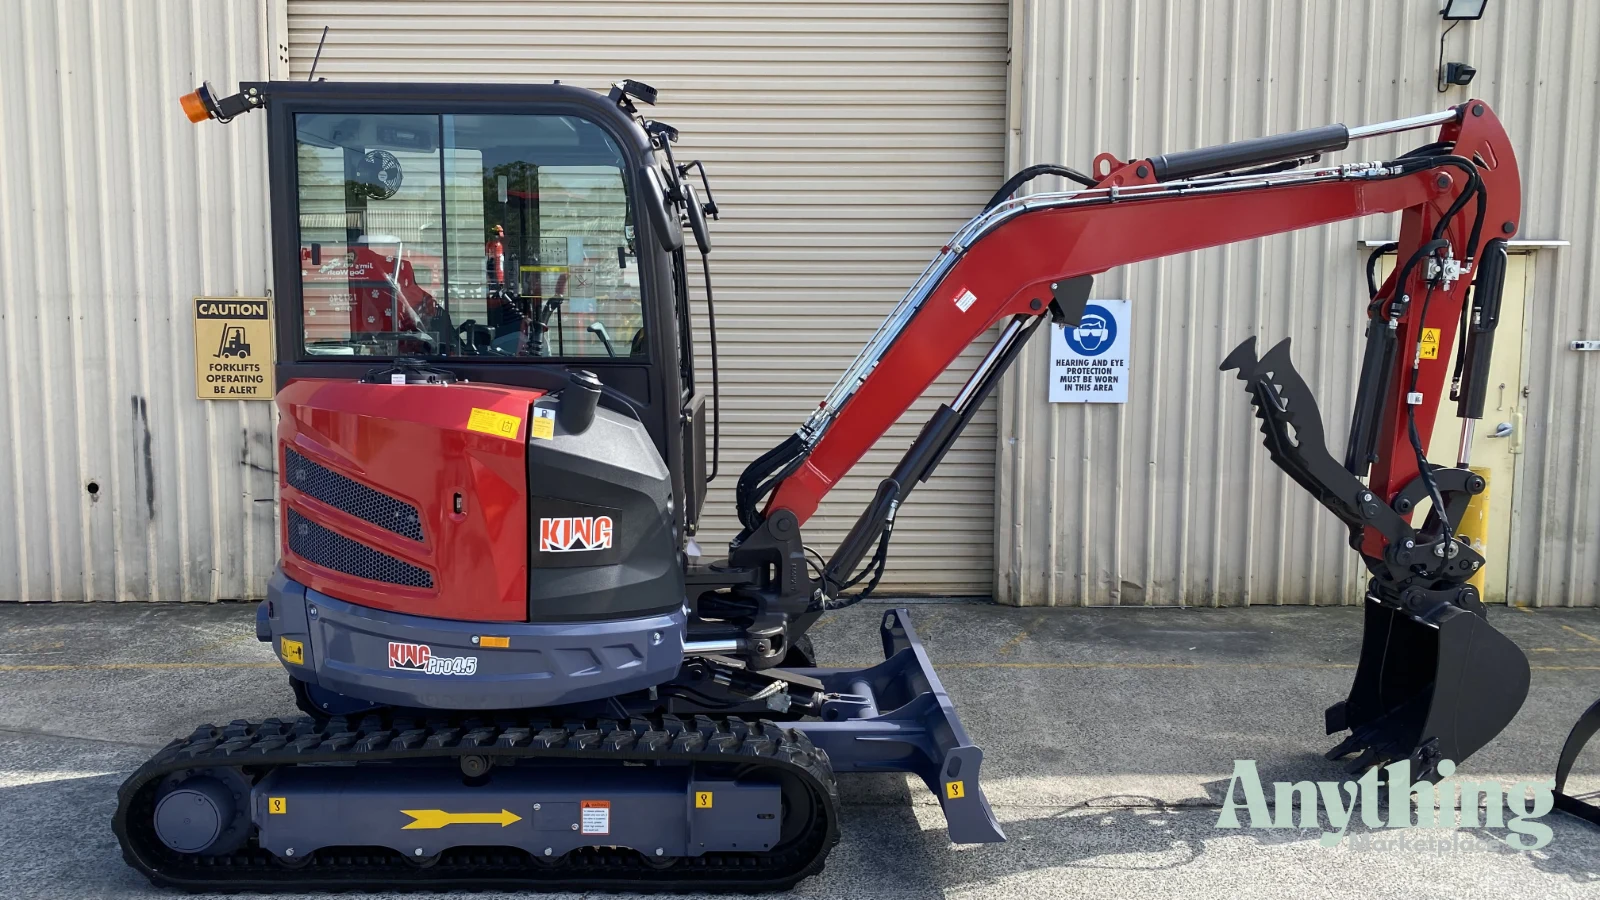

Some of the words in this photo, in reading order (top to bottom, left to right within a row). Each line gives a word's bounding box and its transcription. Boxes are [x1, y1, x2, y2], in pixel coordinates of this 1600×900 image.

[199, 304, 264, 315] CAUTION
[209, 363, 260, 372] FORKLIFTS
[1067, 367, 1112, 375] PROTECTION
[206, 374, 264, 383] OPERATING
[214, 386, 226, 394] BE
[229, 386, 257, 394] ALERT
[540, 516, 613, 551] KING
[388, 642, 431, 670] KING
